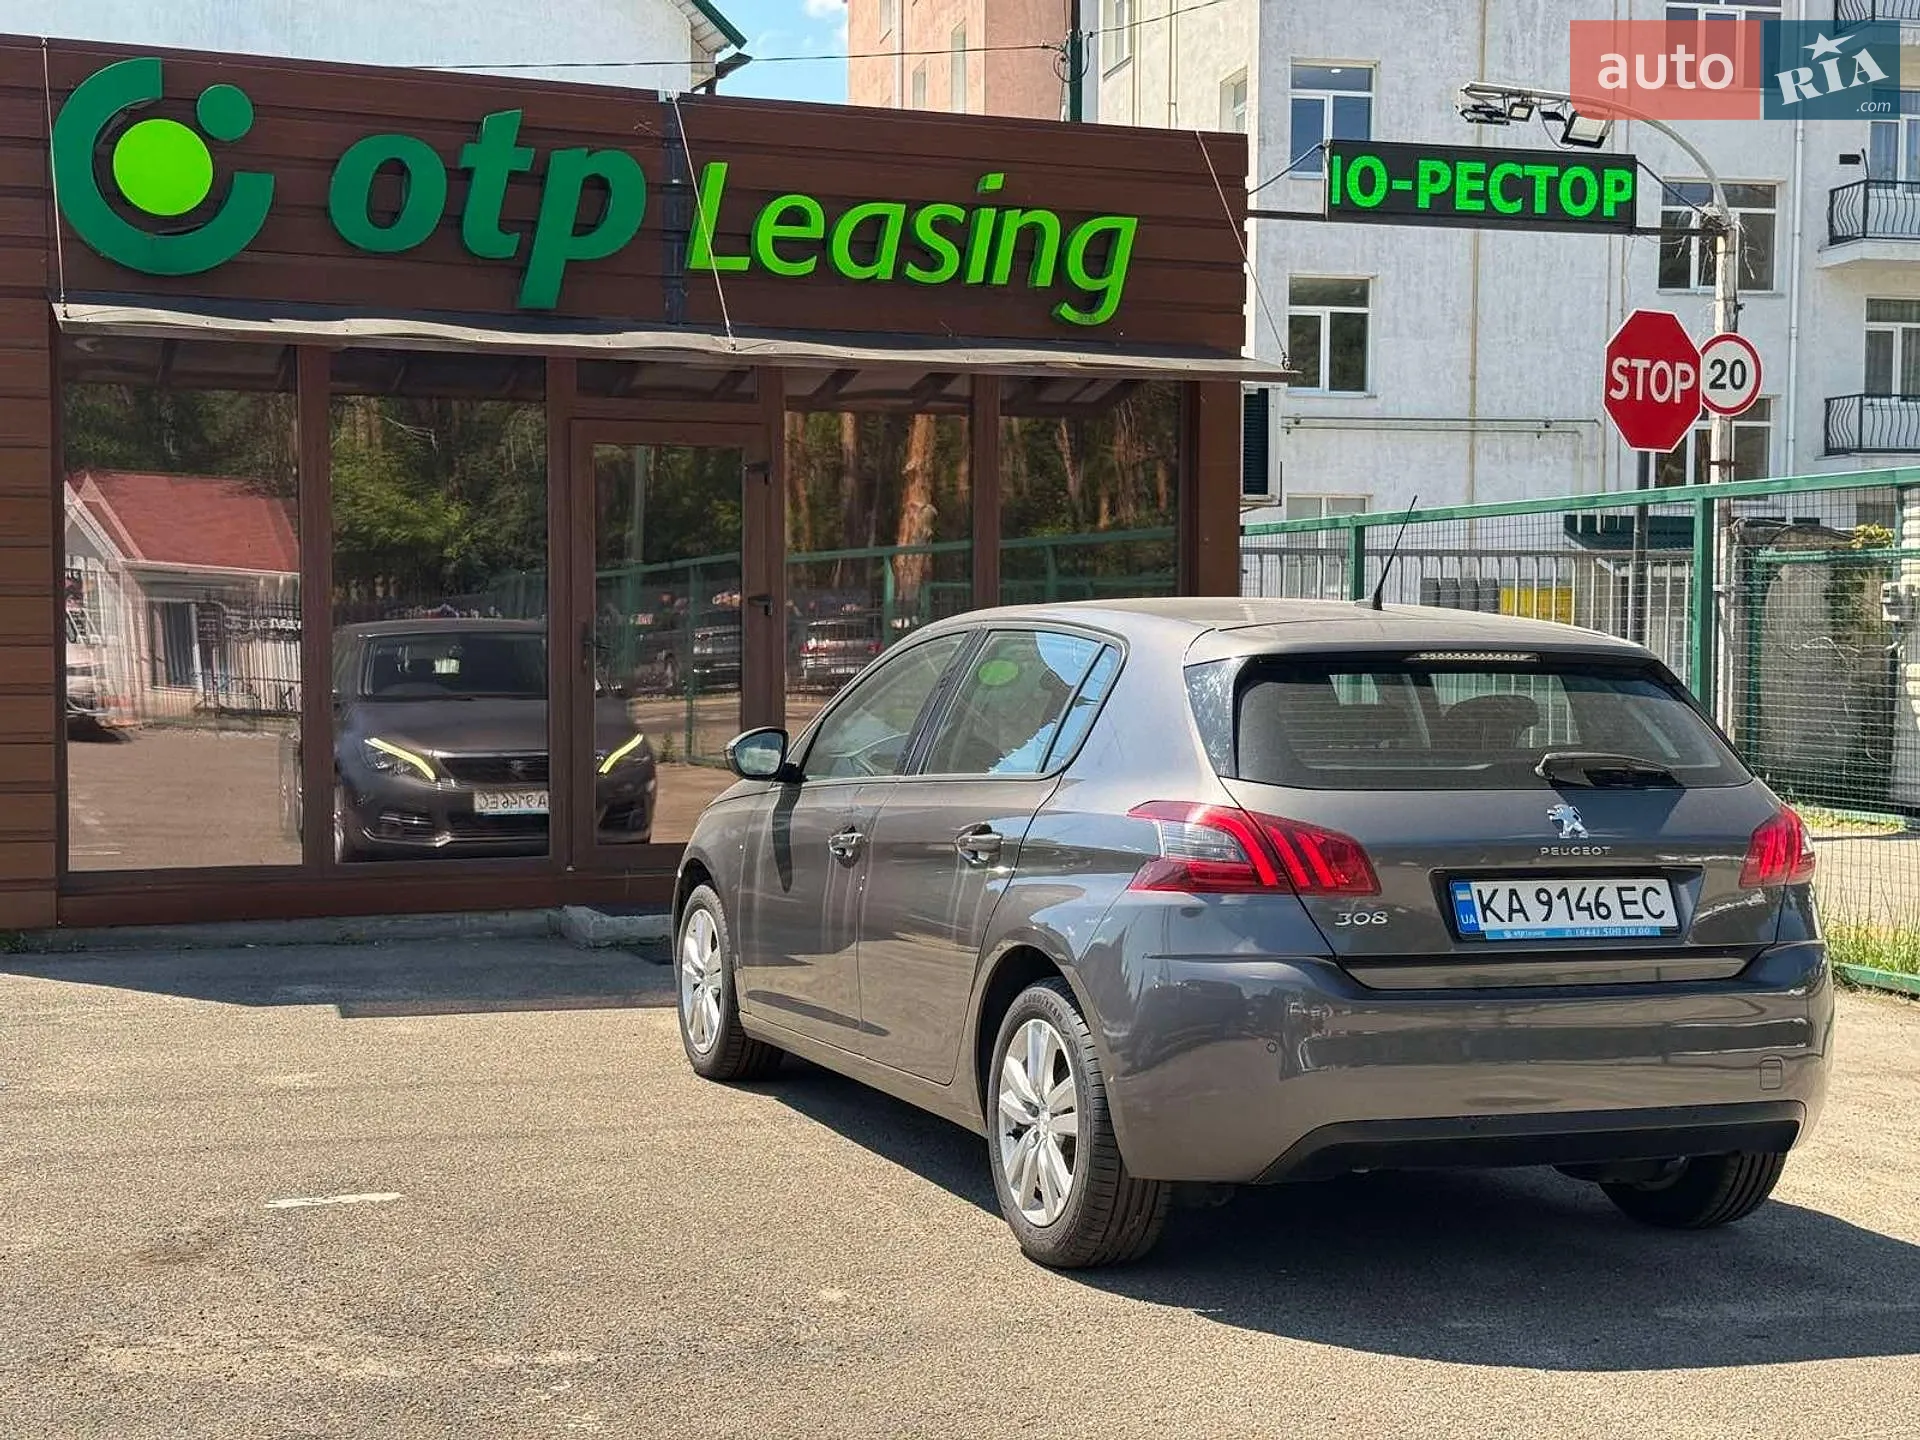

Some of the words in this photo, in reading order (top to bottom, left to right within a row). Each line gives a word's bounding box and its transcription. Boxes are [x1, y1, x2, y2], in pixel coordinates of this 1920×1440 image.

[328, 107, 647, 309] otp
[686, 161, 1139, 325] Leasing
[1608, 356, 1696, 404] STOP
[1708, 358, 1747, 390] 20
[1540, 846, 1611, 856] PEUGEOT
[1334, 911, 1389, 925] 308
[1460, 914, 1477, 925] UA
[1476, 887, 1531, 923] KA
[1534, 886, 1612, 922] 9146
[1617, 886, 1665, 921] EC
